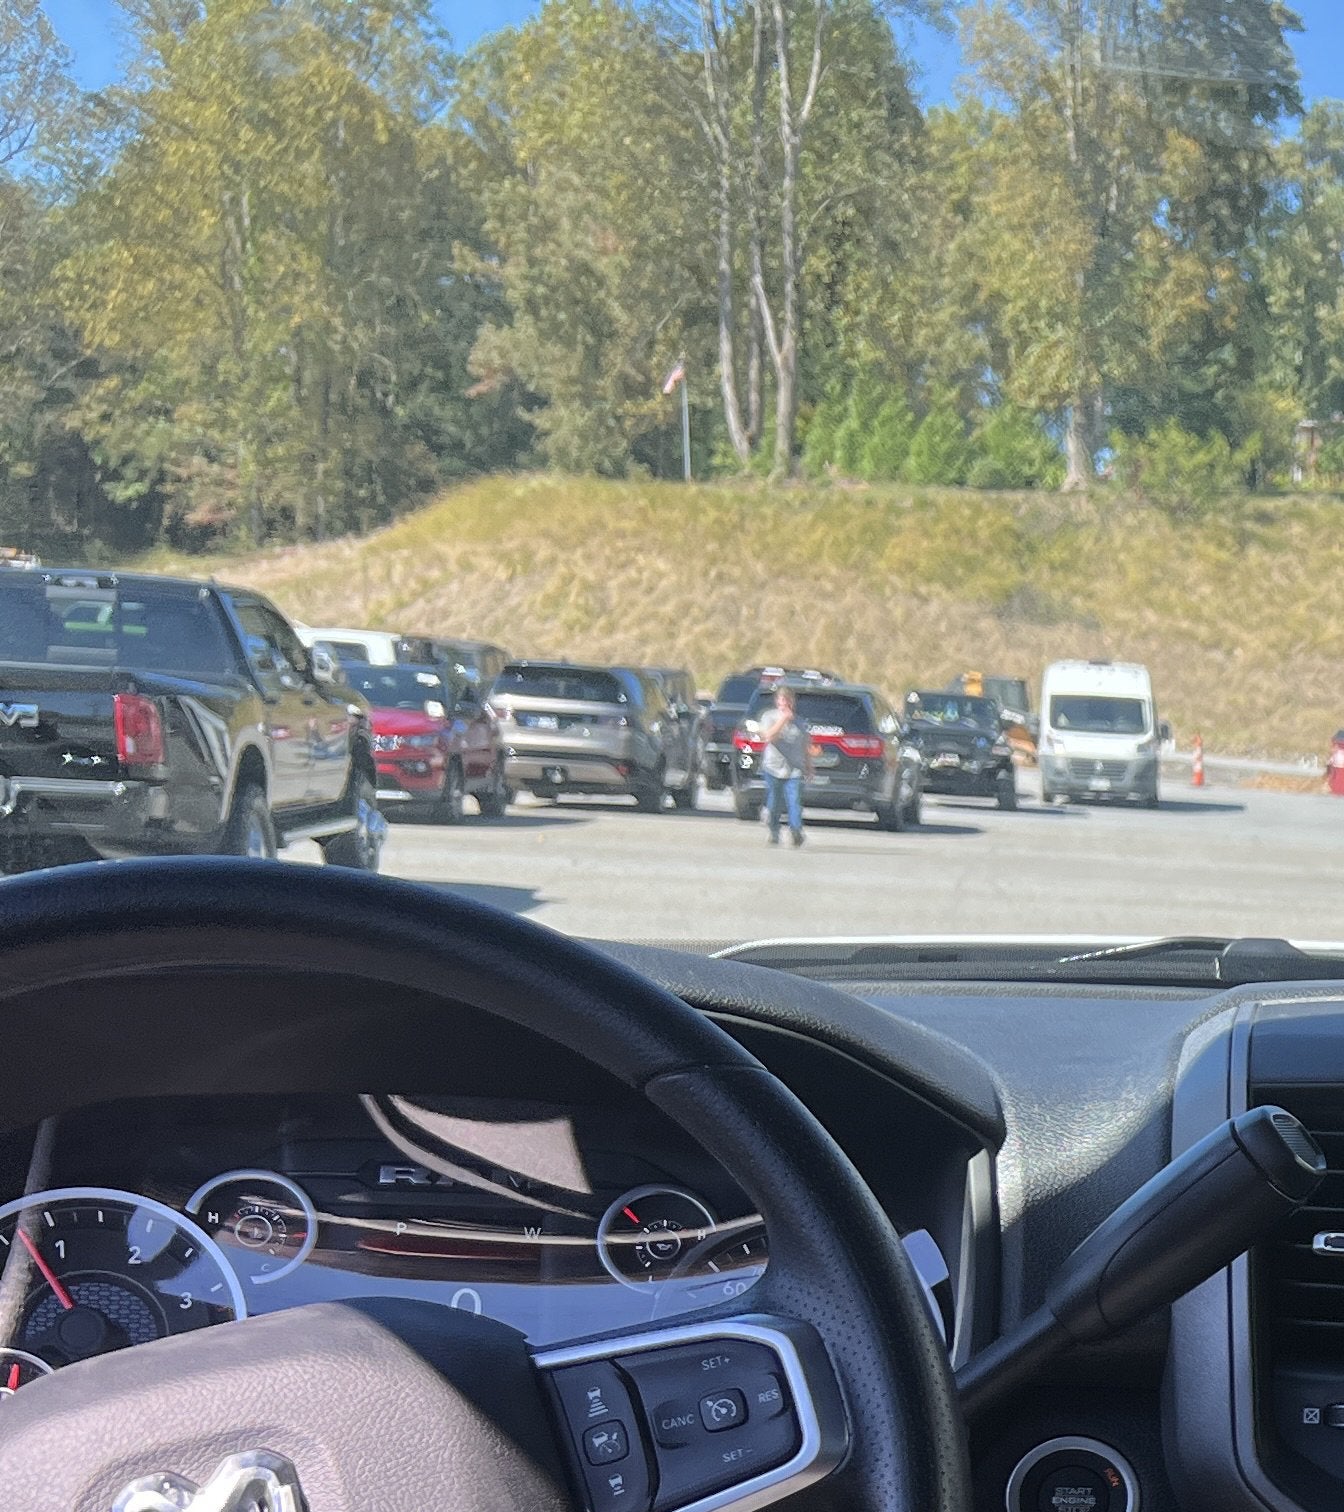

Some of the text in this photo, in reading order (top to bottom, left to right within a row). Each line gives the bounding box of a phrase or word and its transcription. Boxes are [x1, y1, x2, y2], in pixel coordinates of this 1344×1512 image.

[393, 1222, 408, 1236] P
[523, 1225, 542, 1240] W
[54, 1239, 65, 1259] 1
[127, 1245, 142, 1265] 2
[178, 1291, 193, 1310] 3
[758, 1388, 779, 1404] RES
[661, 1413, 695, 1430] CANC
[1055, 1487, 1093, 1495] START
[1051, 1496, 1097, 1505] ENGINE
